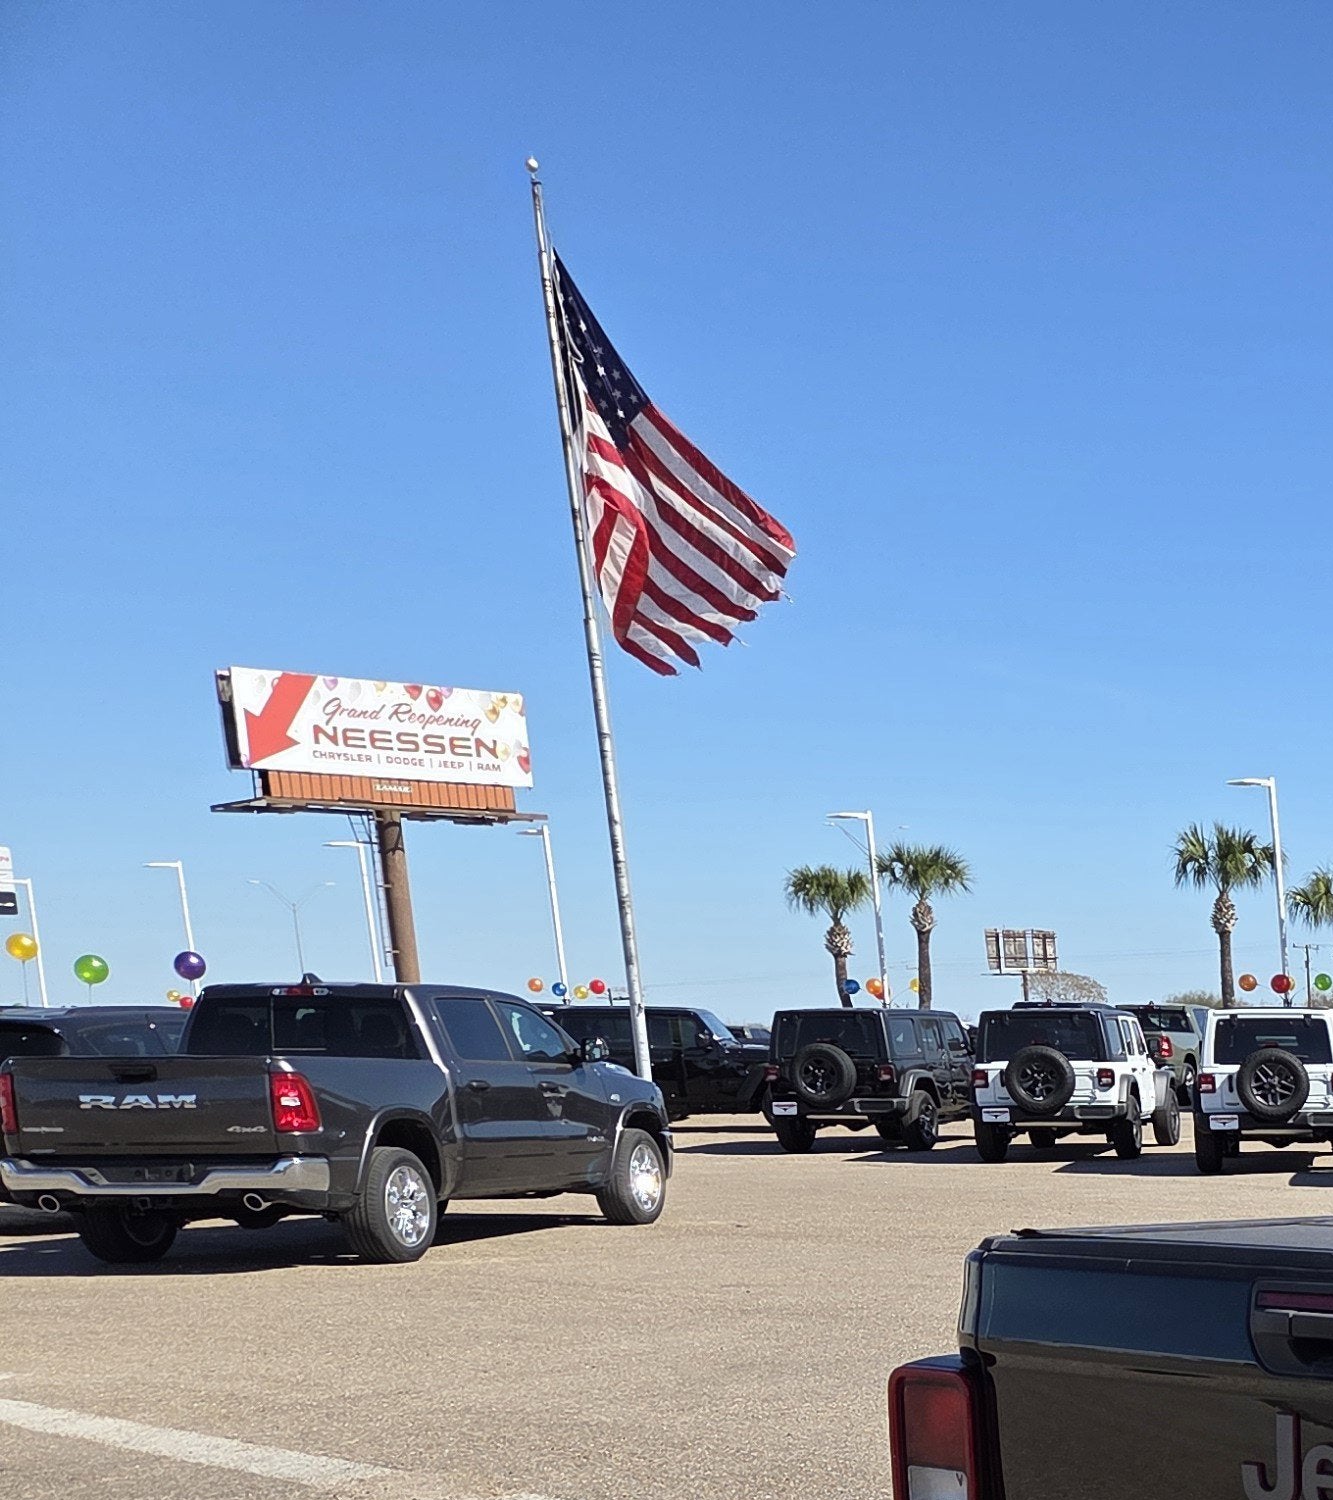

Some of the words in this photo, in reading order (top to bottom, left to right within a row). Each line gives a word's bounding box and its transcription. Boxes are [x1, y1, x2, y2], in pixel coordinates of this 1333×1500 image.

[322, 697, 386, 726] Grand
[388, 702, 482, 736] Reopening
[312, 724, 499, 759] NEESSEN
[312, 750, 373, 763] CHRYSLER
[386, 755, 425, 768] DODGE
[438, 759, 465, 770] JEEP
[477, 762, 502, 773] RAM
[78, 1094, 197, 1110] RAM
